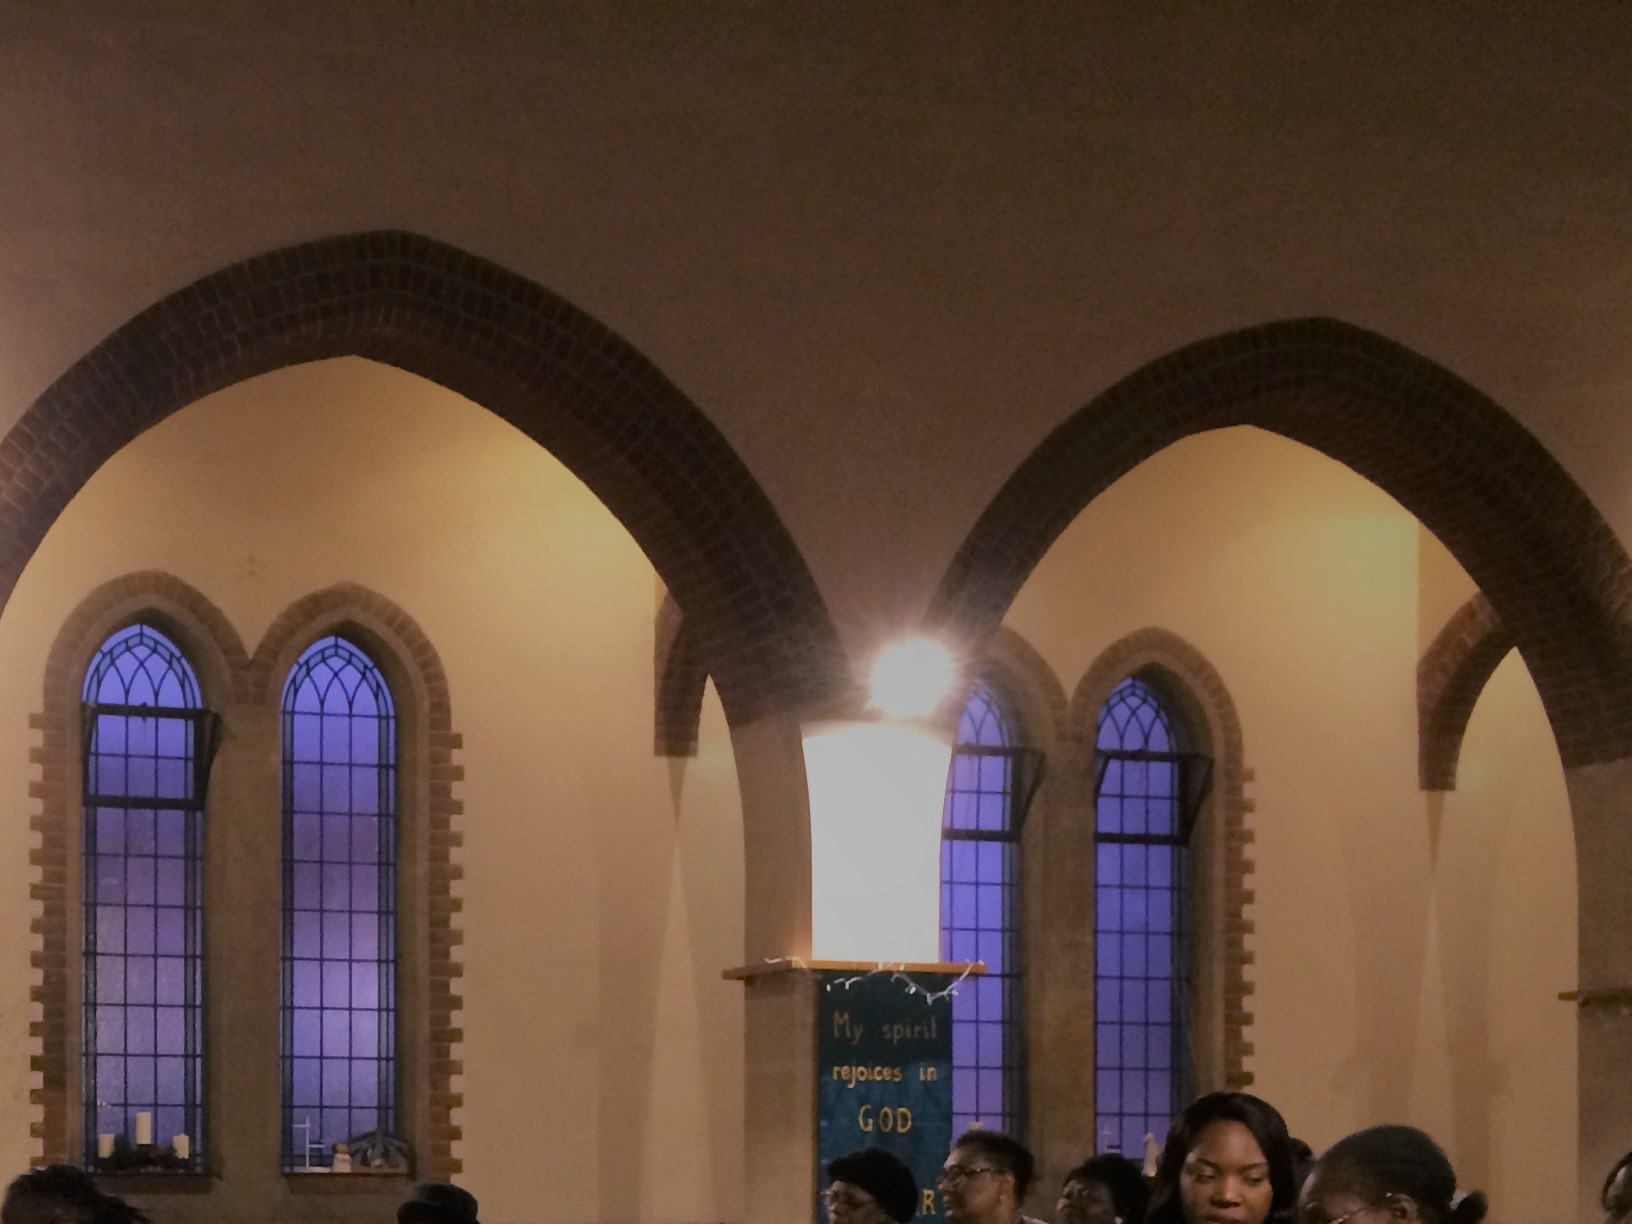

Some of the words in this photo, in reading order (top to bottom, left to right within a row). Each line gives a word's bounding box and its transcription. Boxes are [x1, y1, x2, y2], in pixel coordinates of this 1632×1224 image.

[833, 1010, 863, 1045] My
[882, 1016, 938, 1044] spirit
[832, 1064, 903, 1089] rejoices
[919, 1065, 938, 1081] in
[858, 1104, 913, 1133] GOD
